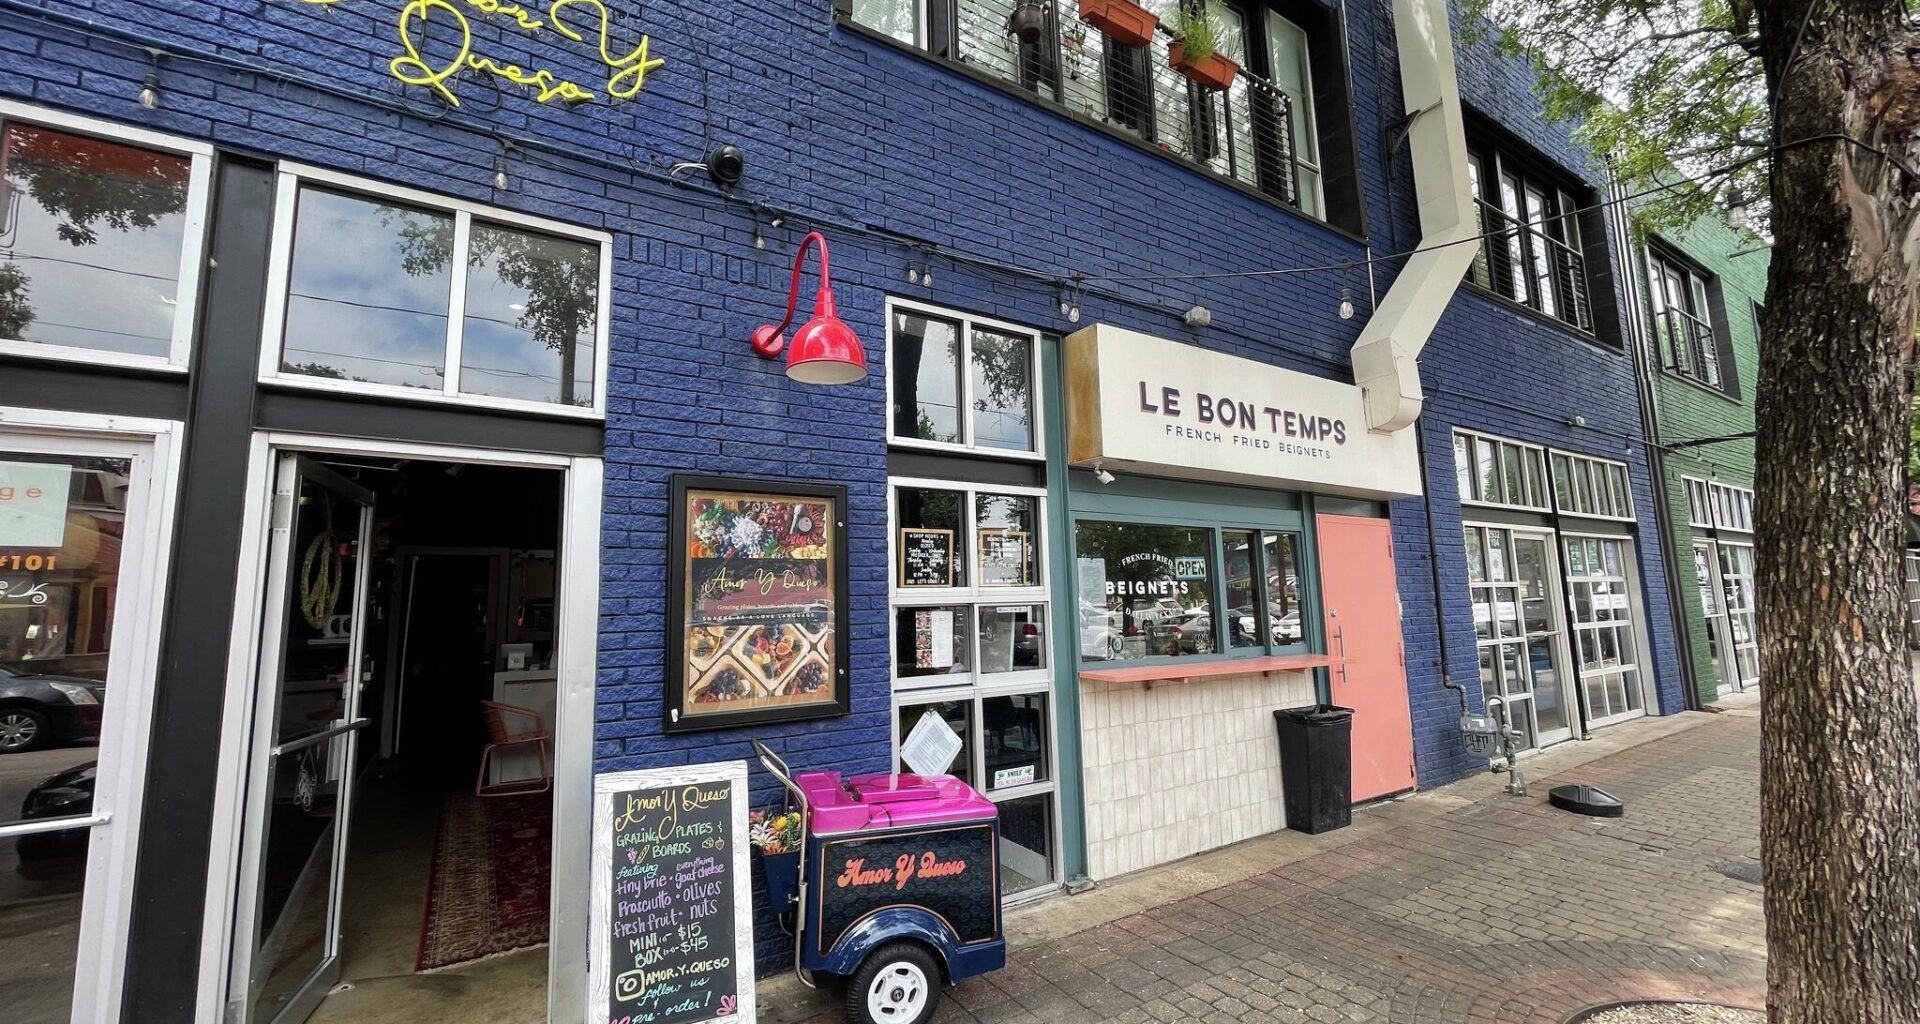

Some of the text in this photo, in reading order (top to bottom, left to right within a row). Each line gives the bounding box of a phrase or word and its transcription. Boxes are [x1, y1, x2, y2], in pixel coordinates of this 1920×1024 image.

[390, 0, 594, 106] Queso
[550, 0, 665, 97] Y
[1139, 381, 1347, 446] LE BON TEMPS
[1166, 424, 1331, 459] FRENCH FRIED BEIGNETS
[1121, 553, 1174, 570] FRENCH FRIED
[1177, 561, 1205, 576] OPEN
[705, 567, 818, 595] Amor Y Queso
[1105, 581, 1189, 595] BEIGNETS
[615, 786, 730, 840] Amor Y Queso
[675, 822, 713, 838] PLATES
[652, 842, 692, 858] BOARDS
[615, 880, 640, 898] tiny
[644, 874, 667, 890] brie
[675, 870, 697, 889] goat
[616, 863, 658, 879] featuring
[837, 851, 966, 890] Amor Y Queso
[683, 880, 722, 902] olives
[613, 899, 718, 938] fresh fruit nuts
[629, 922, 701, 954] MINI $15
[635, 936, 708, 969] BOX $45
[645, 957, 730, 986] AMOR.Y.QUESO
[637, 977, 710, 1007] follow us
